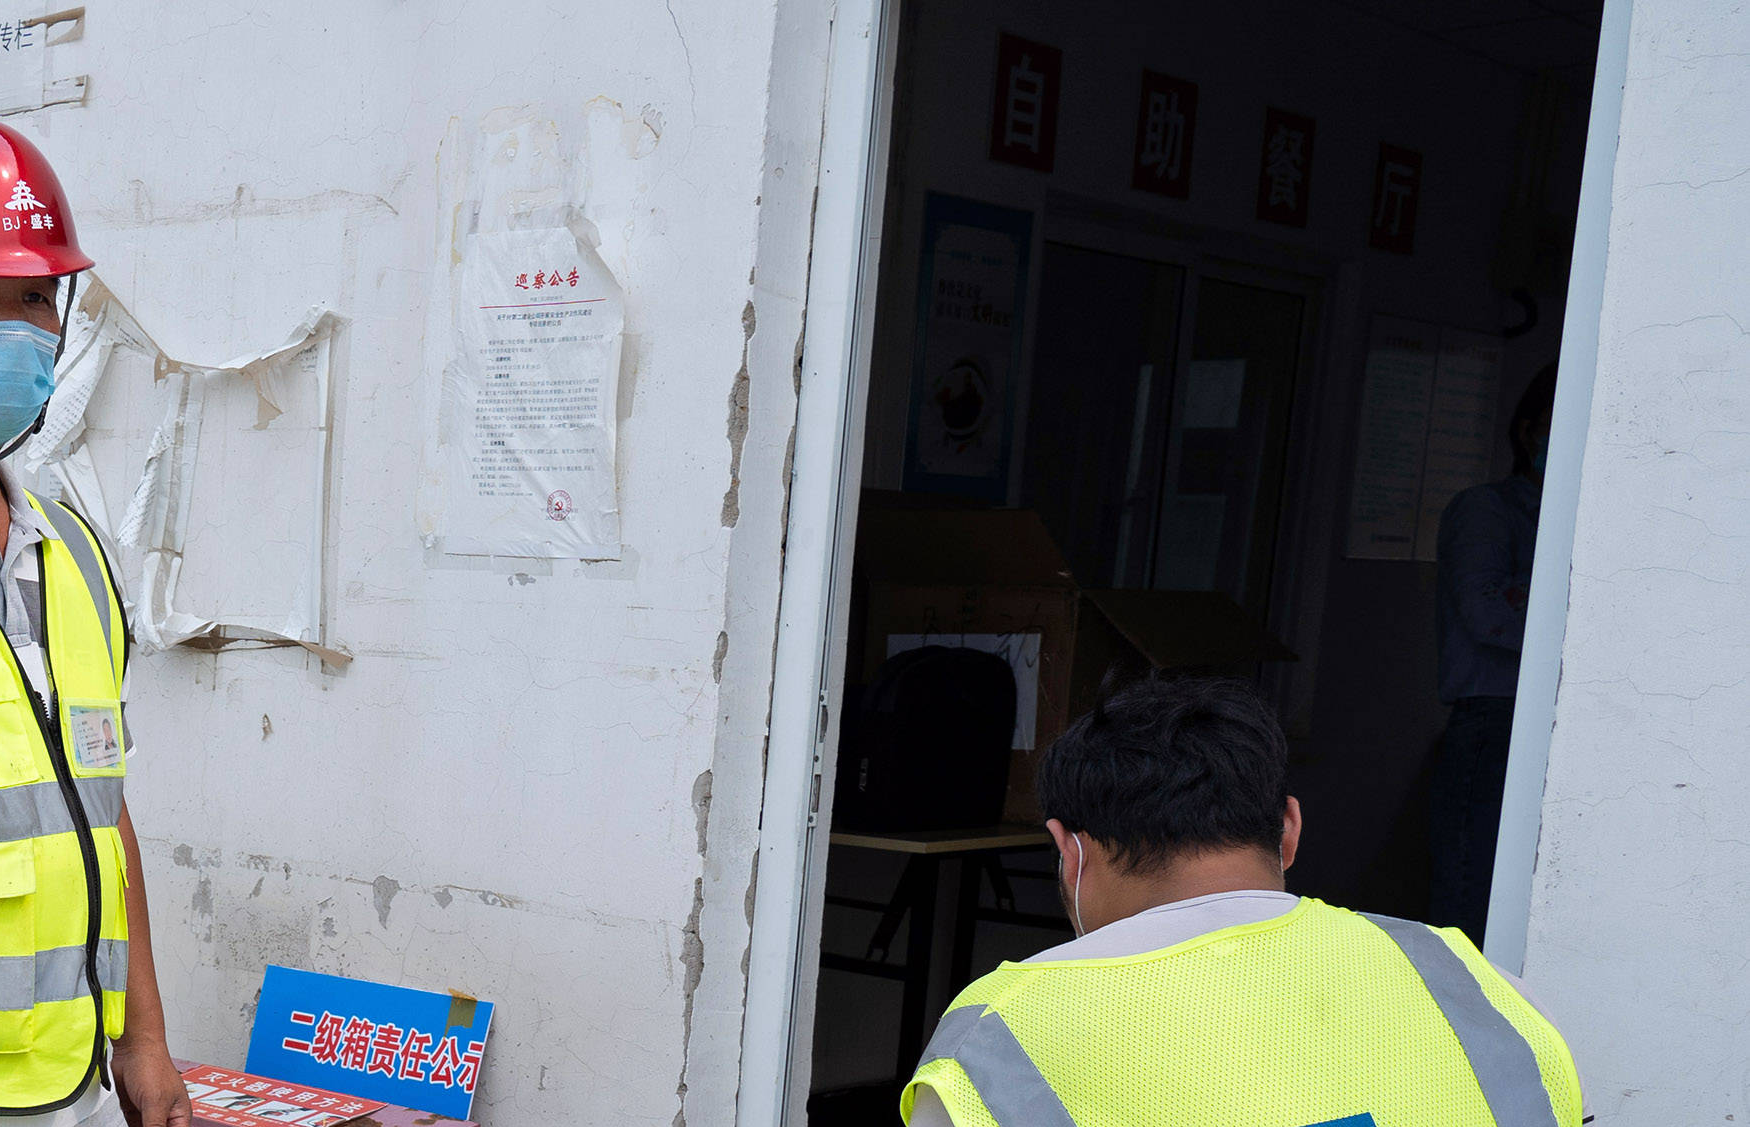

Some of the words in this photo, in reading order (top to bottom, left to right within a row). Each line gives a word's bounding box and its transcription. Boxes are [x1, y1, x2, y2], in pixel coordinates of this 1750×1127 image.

[1003, 56, 1413, 235] 自助餐厅
[199, 1071, 365, 1114] 灭火器使用方法
[283, 1010, 484, 1094] 二级箱责任公示
